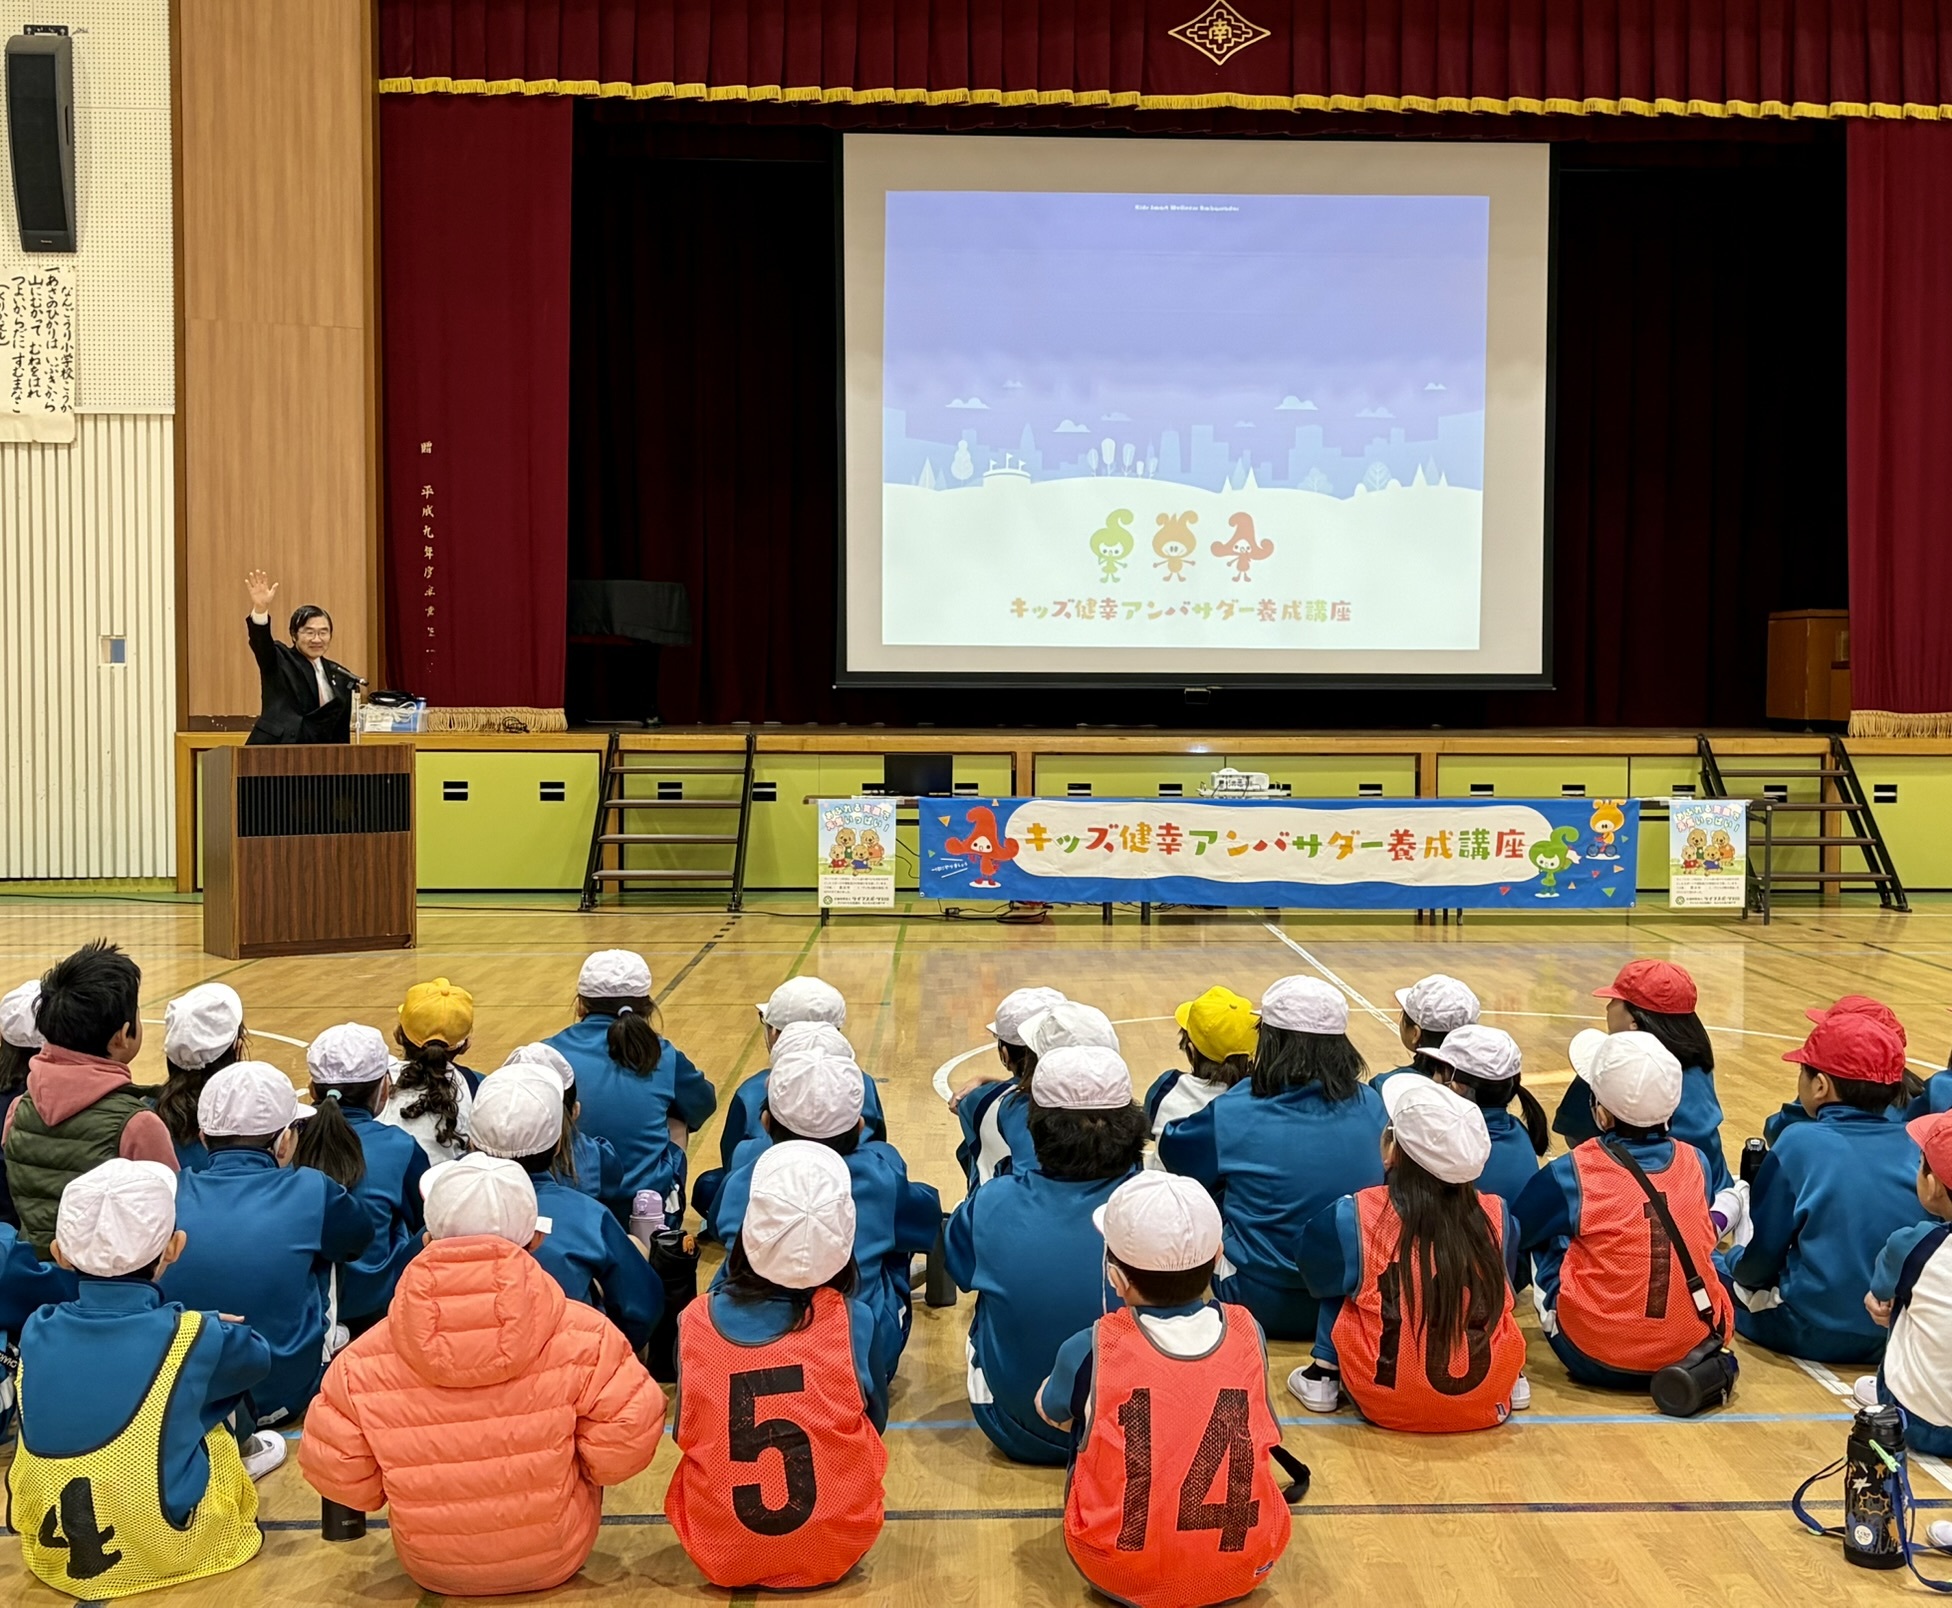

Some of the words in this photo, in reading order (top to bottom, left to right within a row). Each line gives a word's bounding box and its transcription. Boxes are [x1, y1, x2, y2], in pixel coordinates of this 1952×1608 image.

[28, 274, 44, 337] 山にむかって
[1009, 597, 1352, 622] キッズ健幸アンバサダー養成講座
[1025, 821, 1527, 861] キッズ健幸アンバサダー養成講座
[729, 1363, 818, 1537] 5
[1115, 1387, 1261, 1552] 14
[38, 1476, 123, 1580] 4
